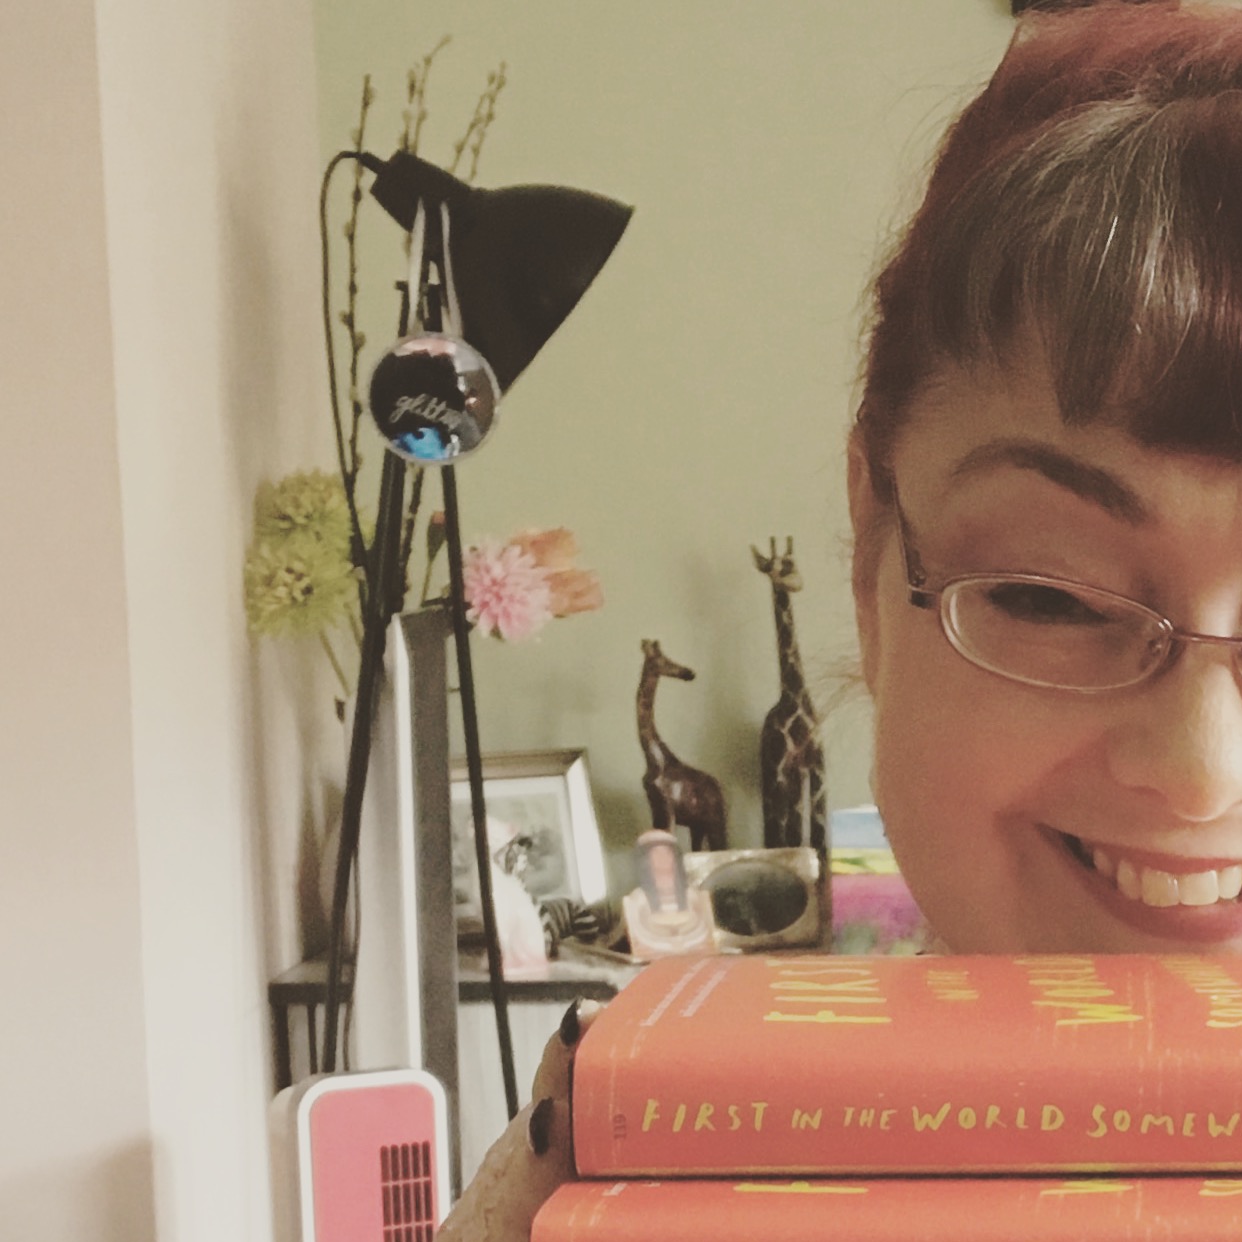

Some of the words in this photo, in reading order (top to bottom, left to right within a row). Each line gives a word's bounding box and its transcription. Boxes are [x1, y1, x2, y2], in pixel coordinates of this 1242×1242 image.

[642, 1099, 768, 1132] FIRST
[792, 1109, 822, 1129] IN
[845, 1108, 896, 1129] THE
[912, 1103, 1064, 1131] WORLD
